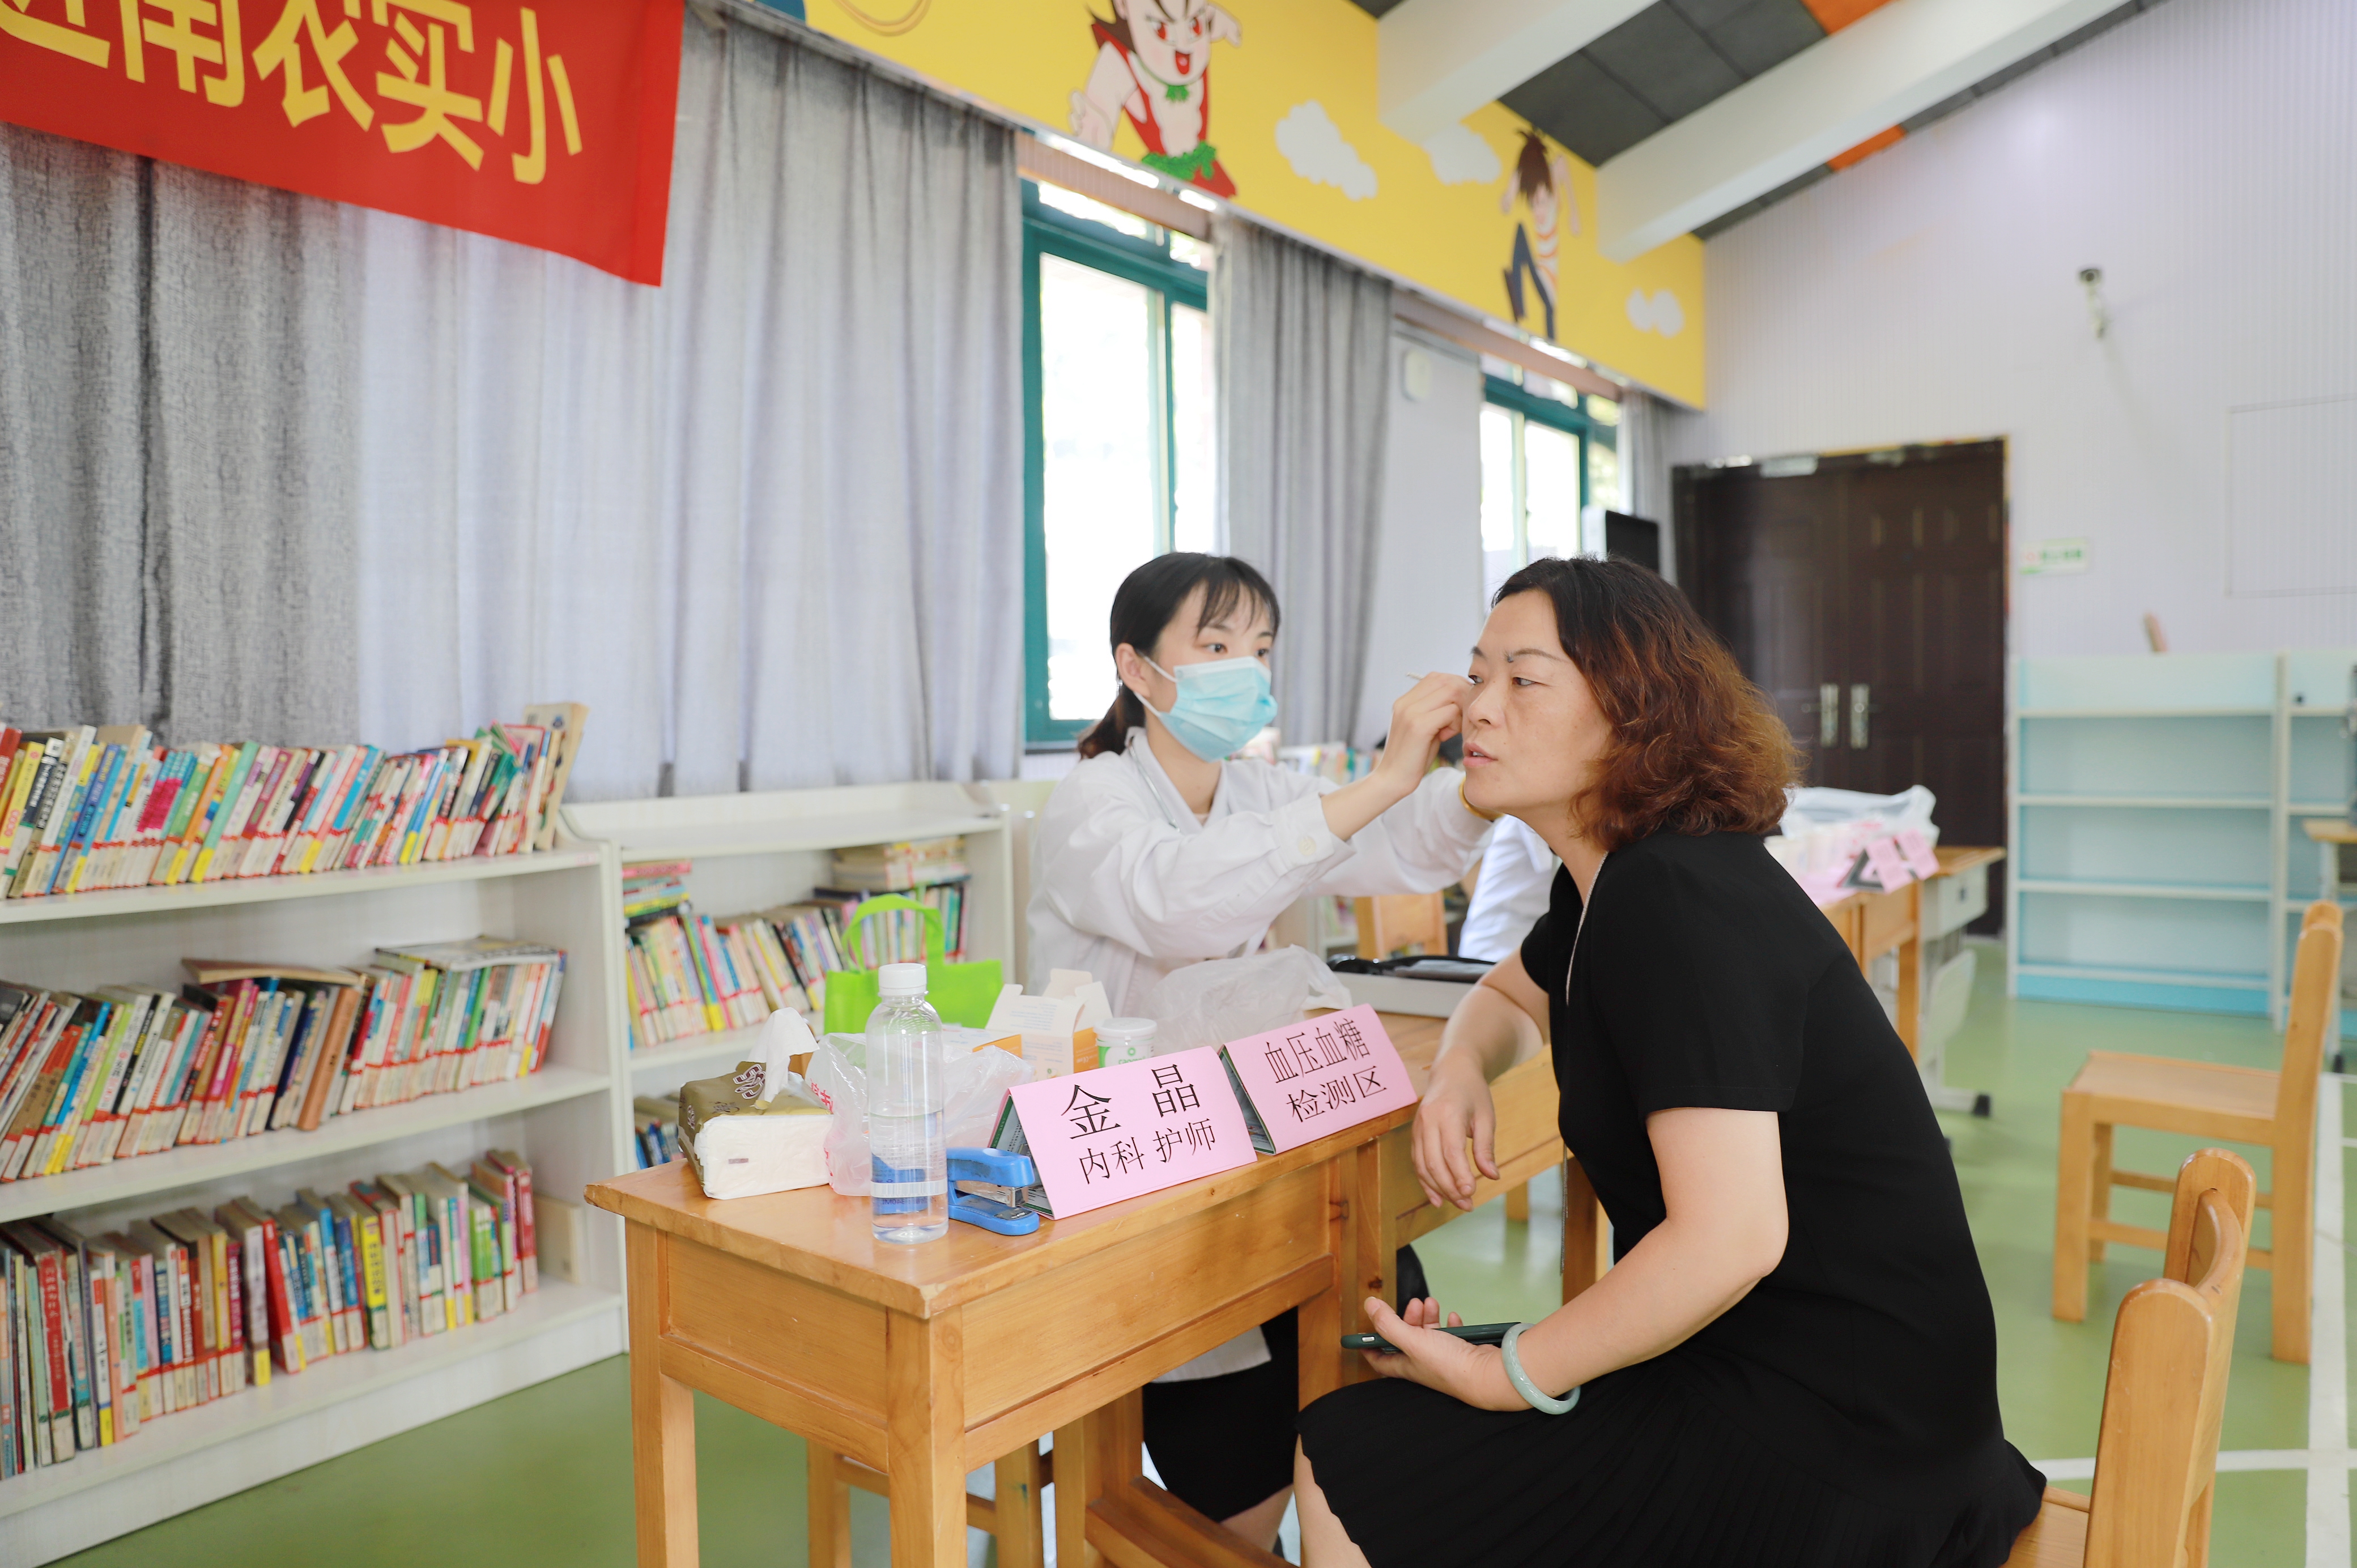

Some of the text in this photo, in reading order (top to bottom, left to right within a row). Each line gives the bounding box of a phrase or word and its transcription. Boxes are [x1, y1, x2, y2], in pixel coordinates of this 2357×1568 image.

[1264, 1019, 1371, 1084] 血压血糖
[1287, 1066, 1388, 1123] 检测区
